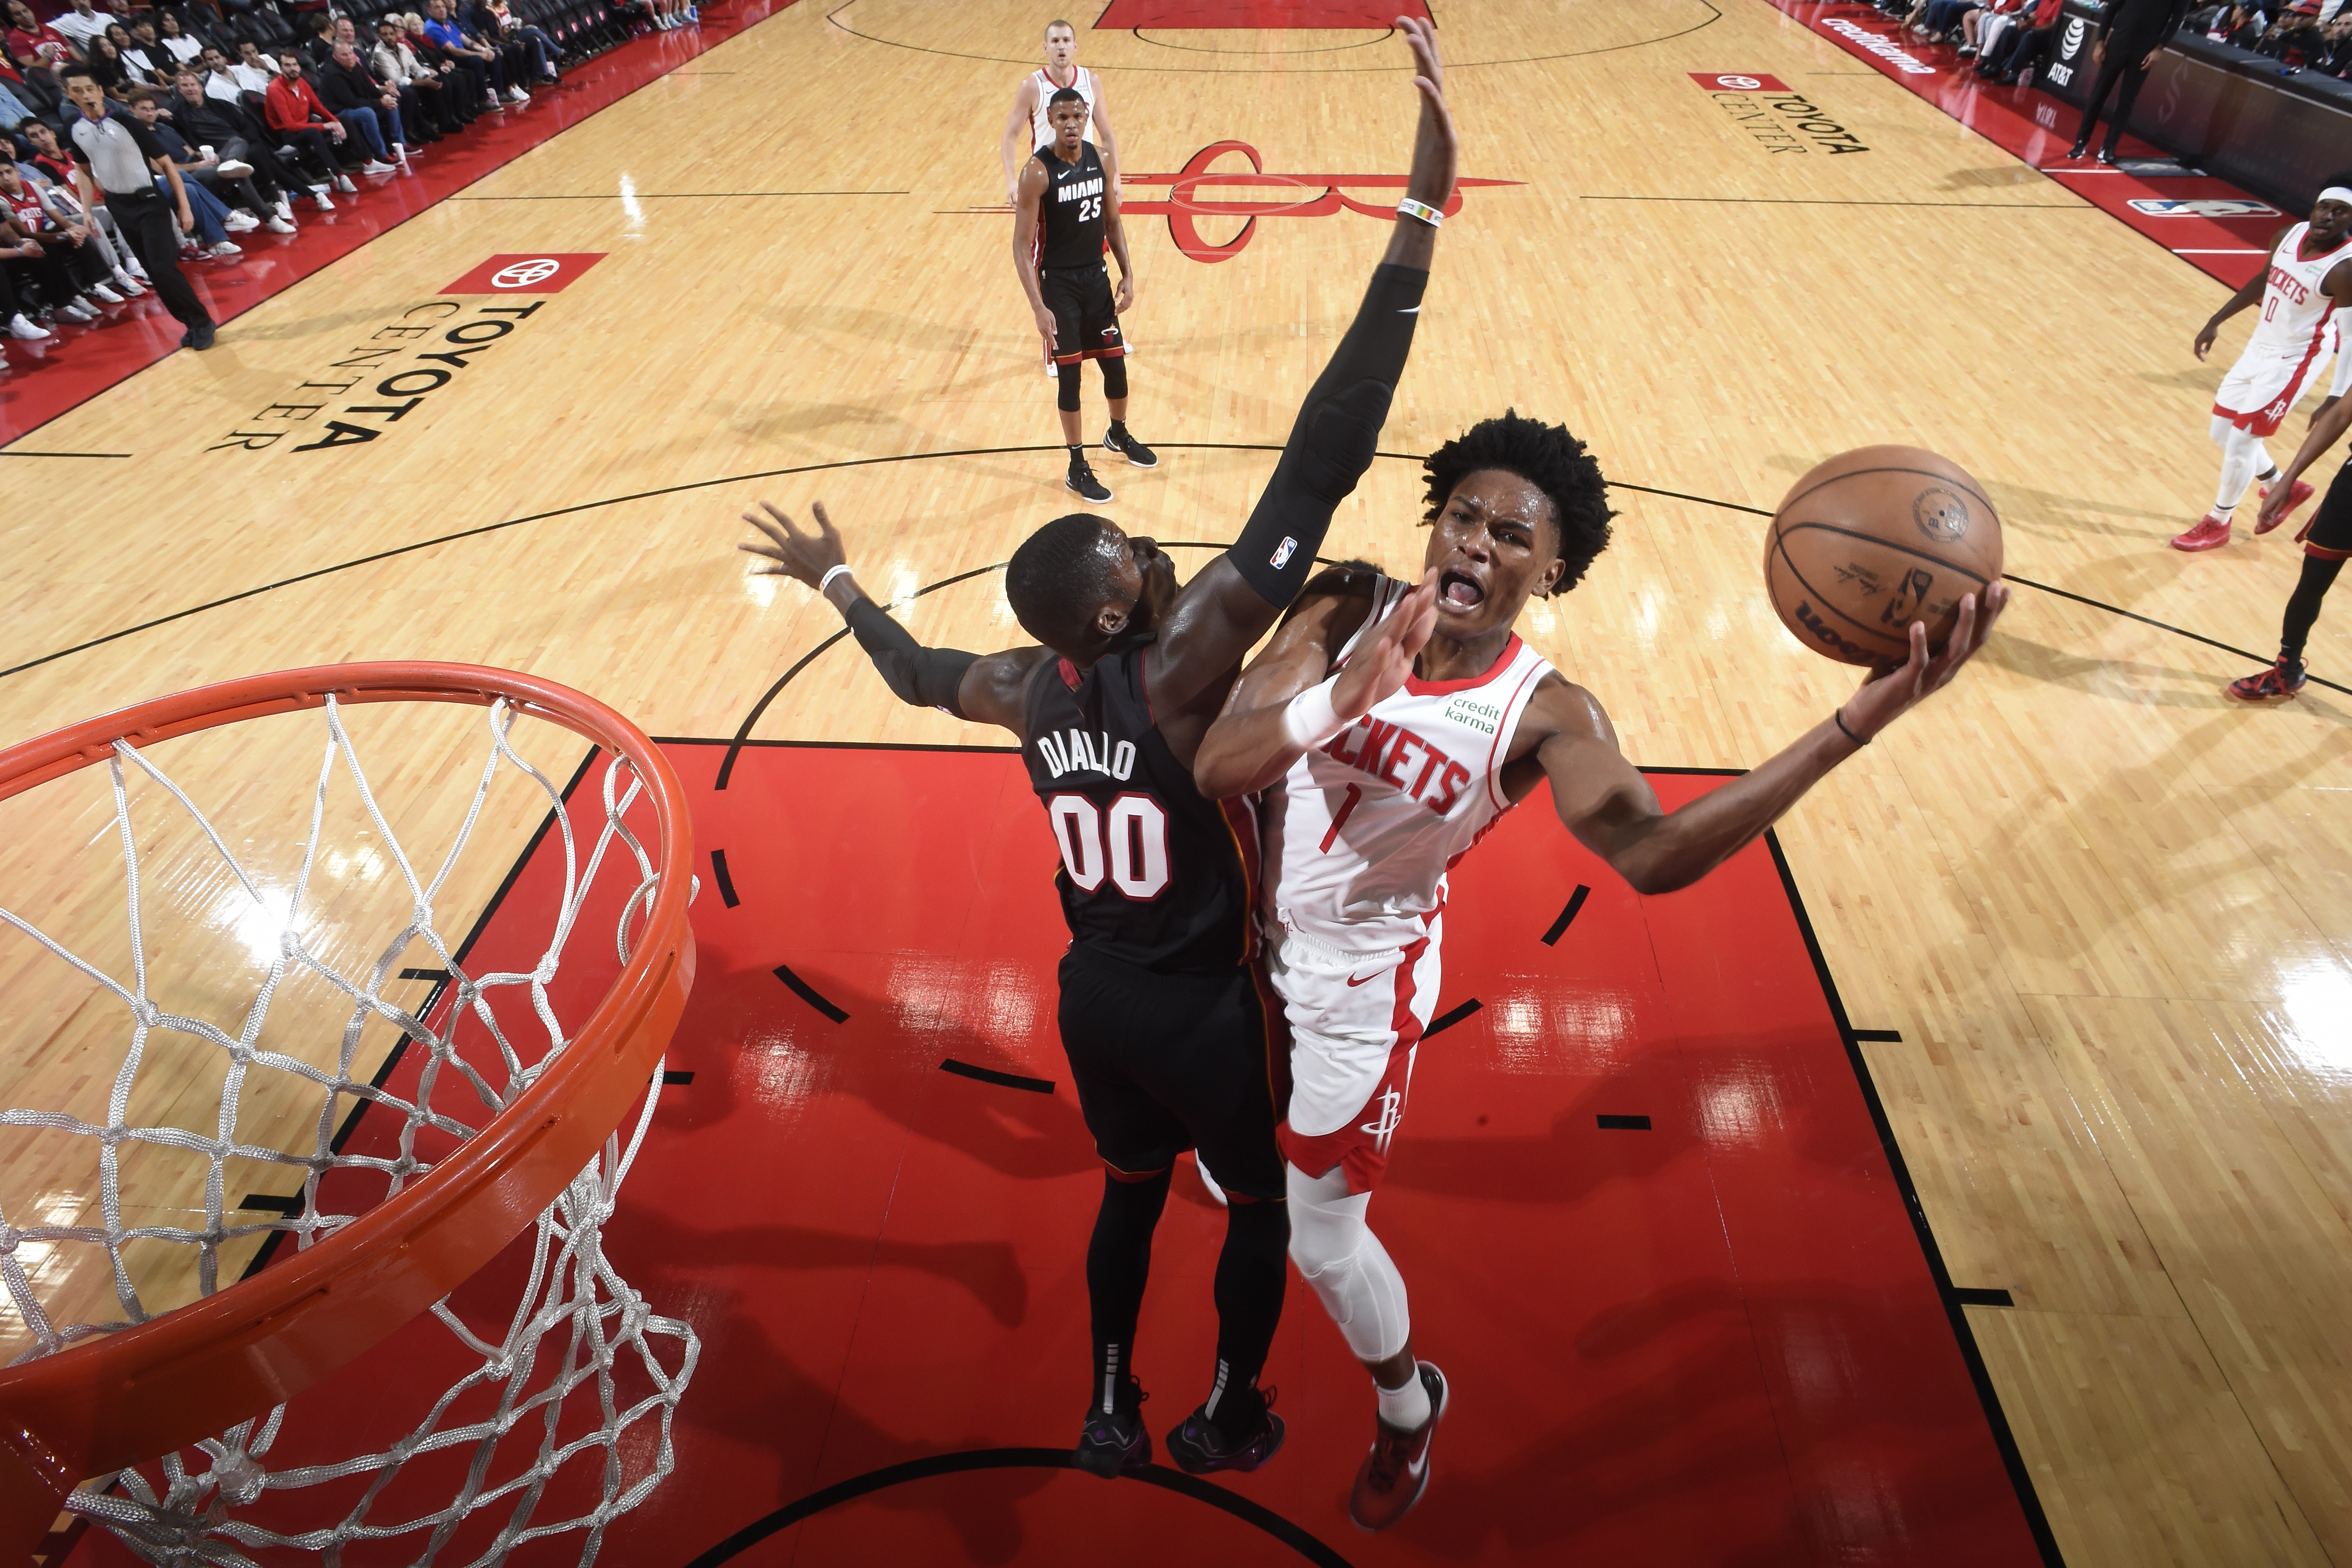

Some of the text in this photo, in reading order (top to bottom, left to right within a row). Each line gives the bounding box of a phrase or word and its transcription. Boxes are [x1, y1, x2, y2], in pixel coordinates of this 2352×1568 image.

[2047, 62, 2073, 87] AT&T
[1712, 93, 1807, 154] CENTER
[1764, 95, 1870, 154] TOYOTA
[1058, 177, 1103, 203] MIAMI
[1079, 196, 1102, 222] 25
[2267, 265, 2309, 305] OCKETS
[2265, 296, 2279, 322] 0
[204, 301, 460, 453] CENTER
[290, 301, 546, 453] TOYOTA
[1445, 706, 1494, 735] karma
[1454, 699, 1500, 720] credit
[1037, 728, 1137, 781] DIALLO
[1320, 713, 1471, 815] CKETS
[1049, 791, 1173, 902] 00
